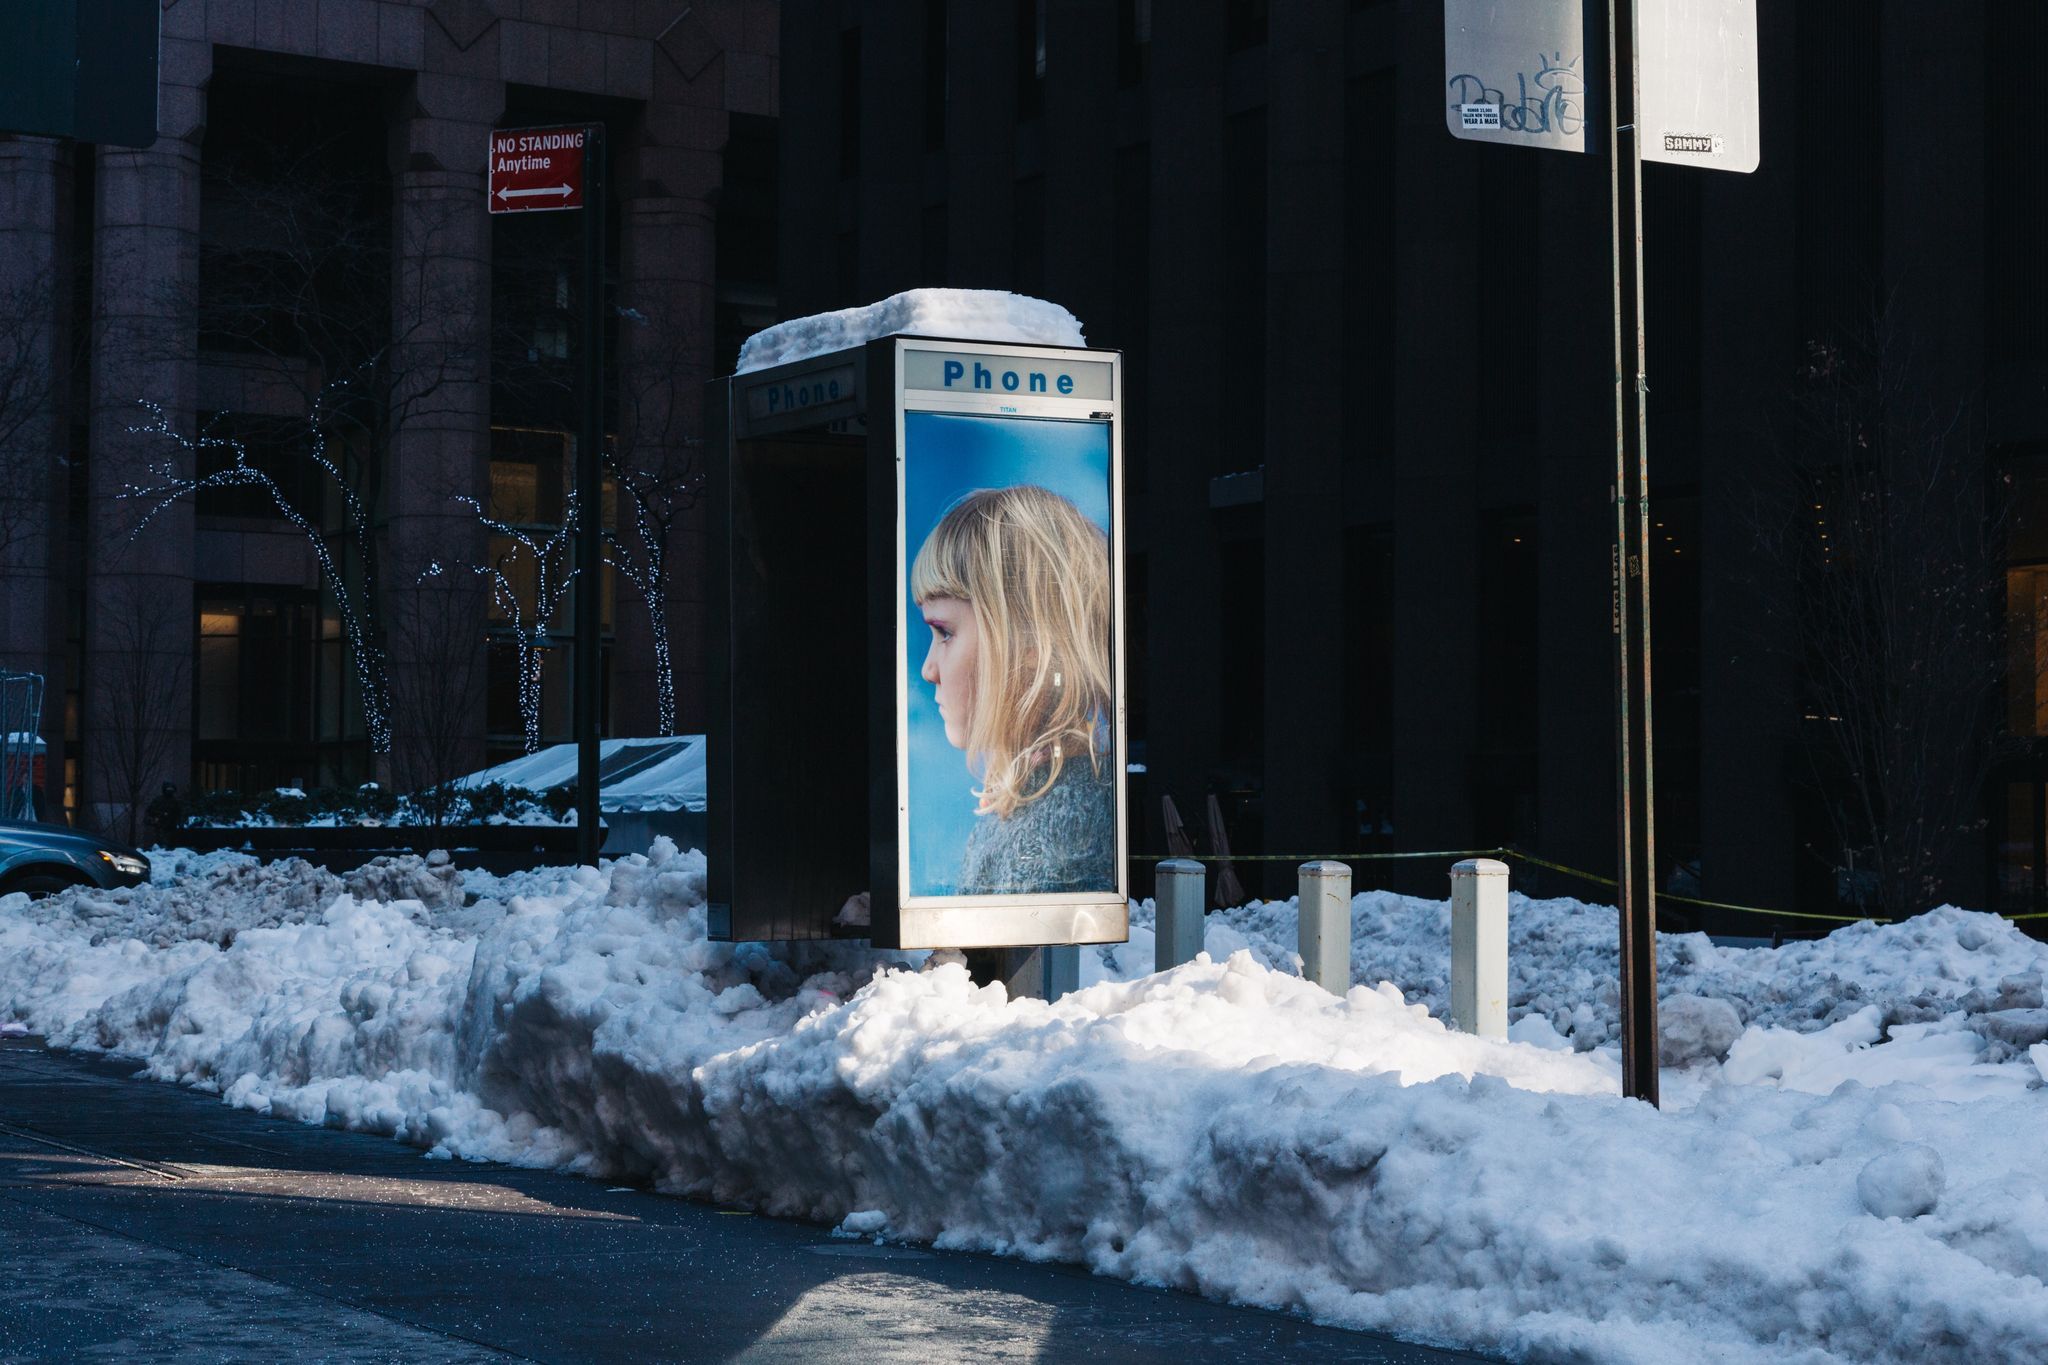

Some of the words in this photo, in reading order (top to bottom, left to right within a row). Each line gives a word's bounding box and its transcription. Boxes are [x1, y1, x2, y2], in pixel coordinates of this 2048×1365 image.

[497, 138, 515, 153] NO
[519, 133, 583, 152] STANDING
[1665, 137, 1711, 151] SAMMY
[497, 155, 551, 174] Anytime
[944, 360, 1074, 394] Phone
[768, 380, 838, 412] Phone
